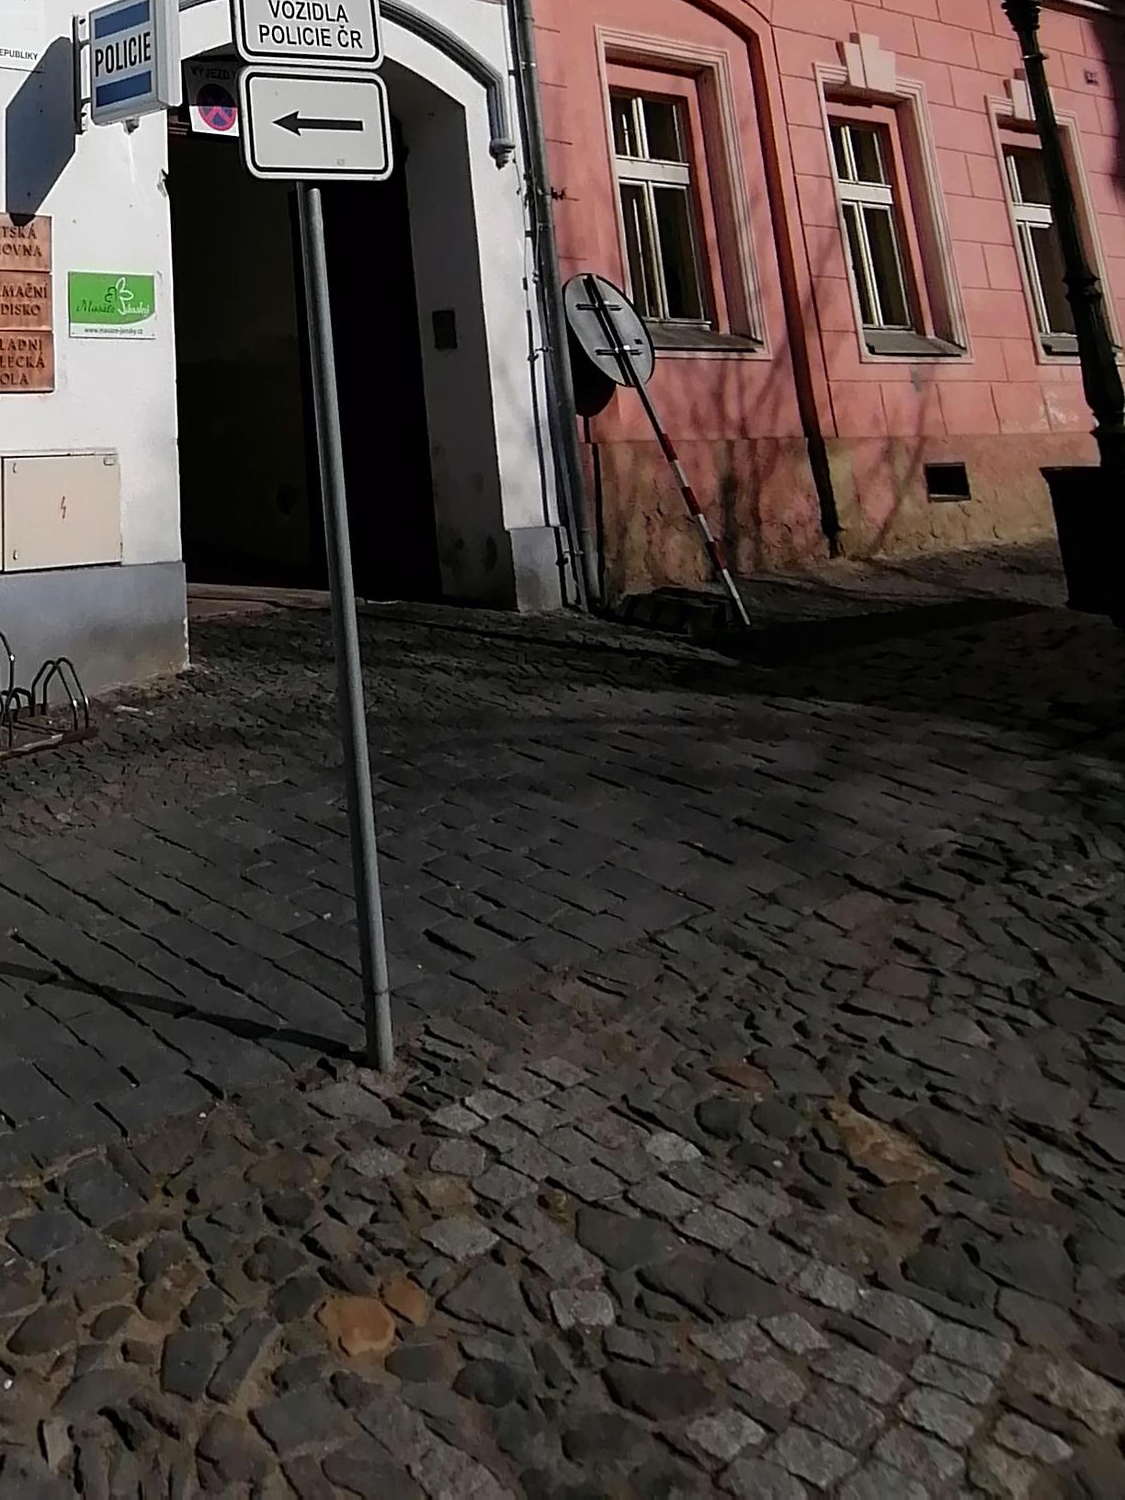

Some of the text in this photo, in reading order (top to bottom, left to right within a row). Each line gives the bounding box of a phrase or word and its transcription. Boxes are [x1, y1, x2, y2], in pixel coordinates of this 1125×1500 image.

[268, 0, 349, 23] VOZIDLA
[258, 24, 363, 49] POLICIE ČR
[95, 31, 152, 77] POLICIE
